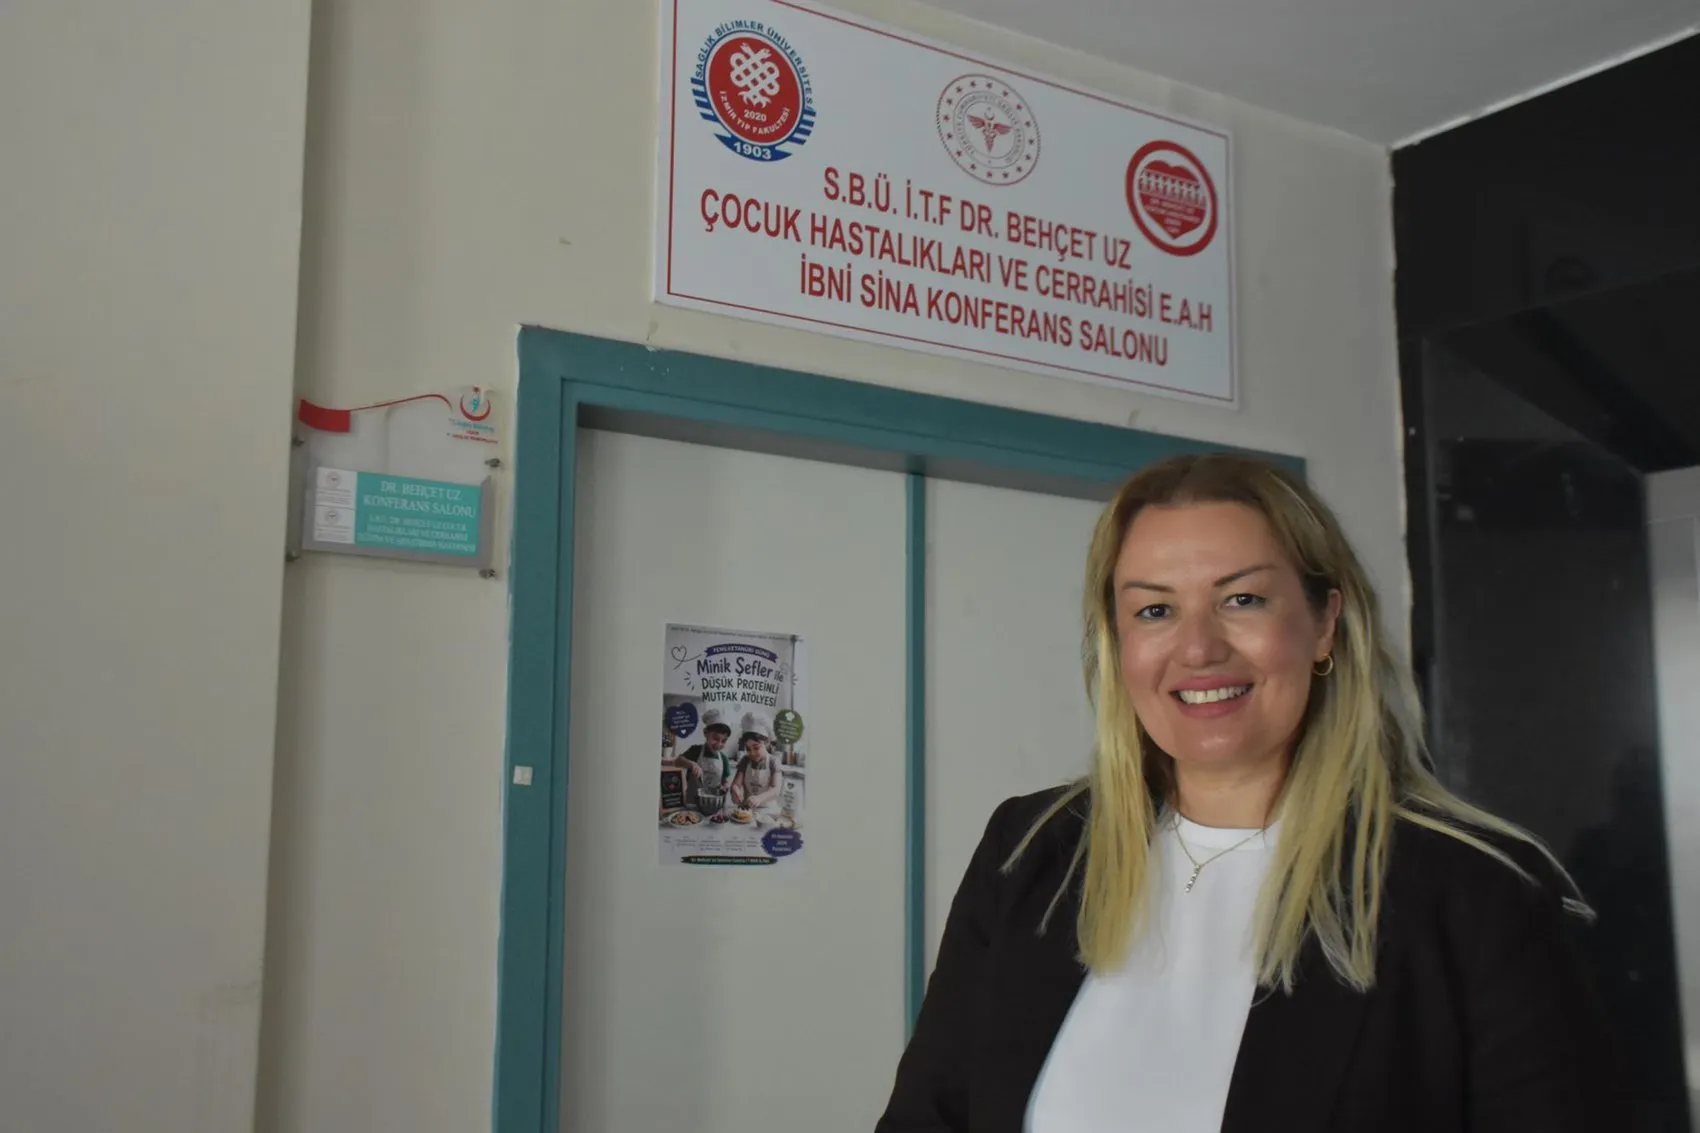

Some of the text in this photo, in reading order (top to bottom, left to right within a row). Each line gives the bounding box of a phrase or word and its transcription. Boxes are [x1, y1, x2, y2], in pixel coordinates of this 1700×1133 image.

[743, 108, 767, 122] 2020
[733, 141, 772, 160] 1903
[824, 166, 1132, 270] S.B.Ü. İ.T.F DR. BEHÇET UZ
[700, 188, 1214, 333] ÇOCUK HASTALIKLARI VE CERRAHİSİ E.A.H
[800, 253, 1168, 367] İBNİ SİNA KONFERANS SALONU
[402, 483, 445, 499] BEHÇET
[446, 488, 462, 501] UZ
[363, 494, 431, 513] KONFERANS
[431, 501, 476, 519] SALONU
[696, 657, 732, 675] Minik
[735, 656, 773, 678] Şefler
[701, 676, 779, 695] DÜŞÜK PROTEİNLİ
[702, 691, 778, 708] MUTFAK ATÖLYESİ
